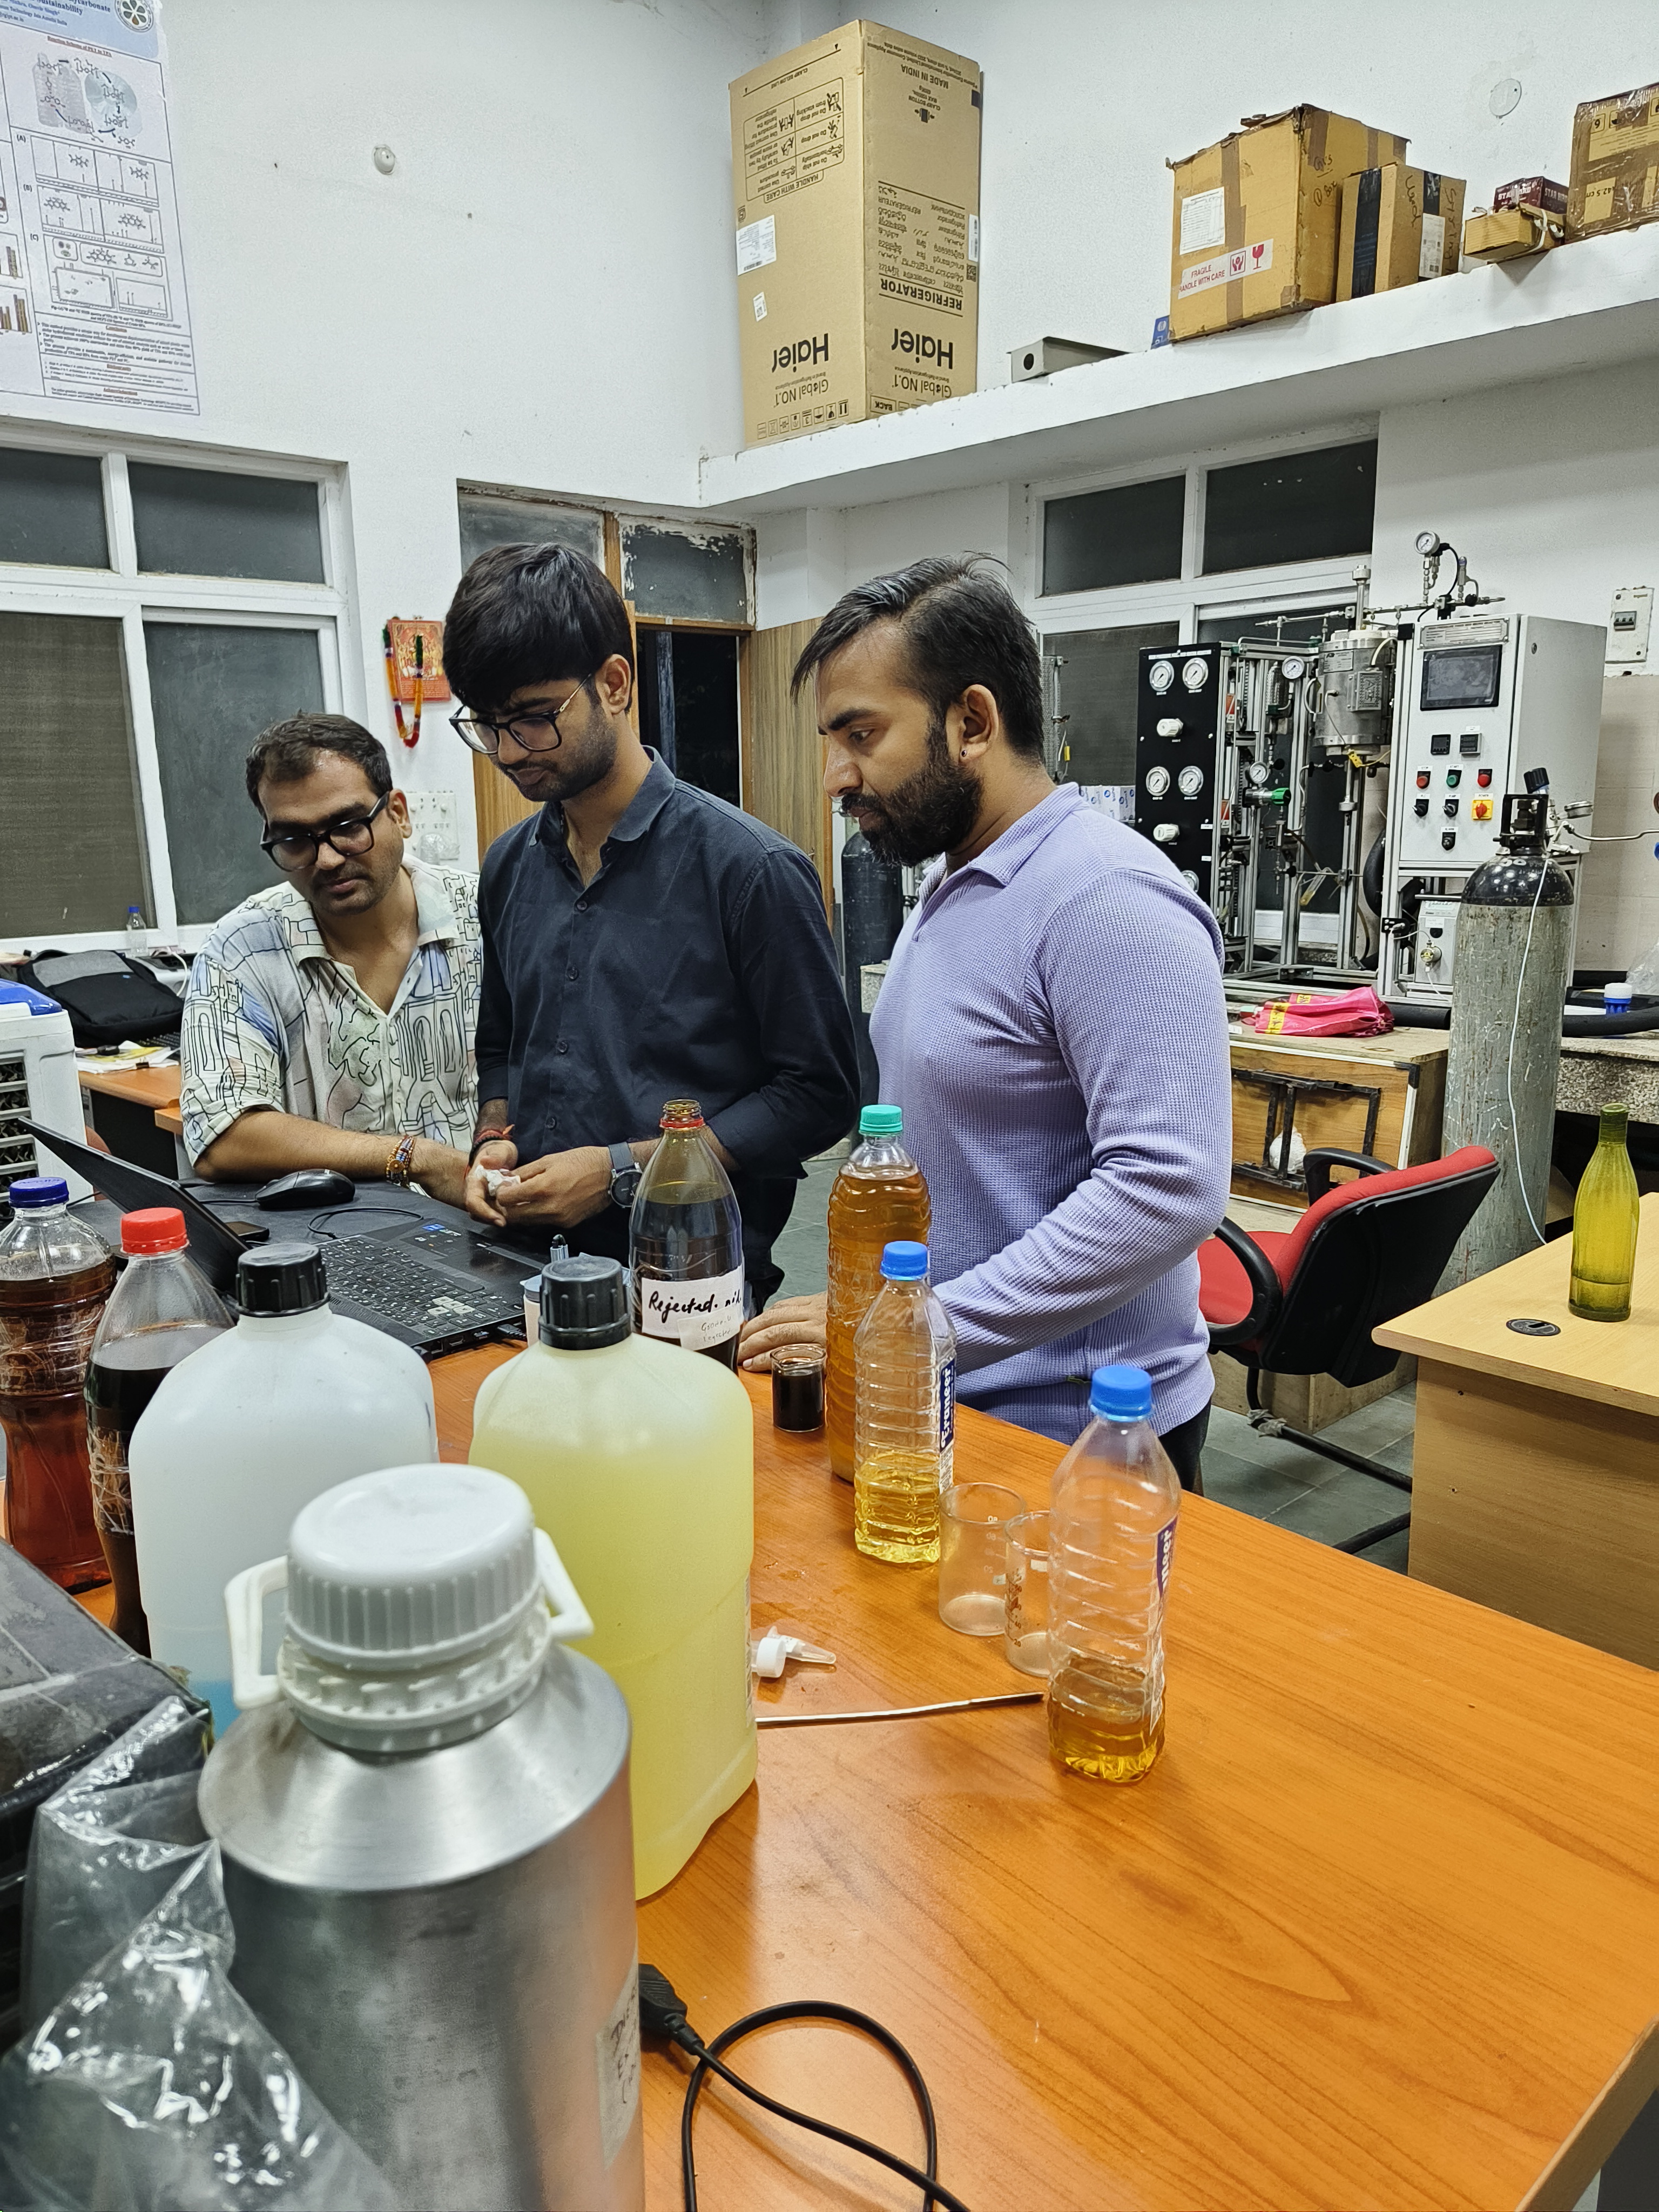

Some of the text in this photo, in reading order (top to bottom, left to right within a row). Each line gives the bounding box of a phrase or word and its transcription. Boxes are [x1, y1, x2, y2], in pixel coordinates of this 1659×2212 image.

[37, 0, 83, 15] ustainability
[901, 64, 949, 89] MADE IN INDIA
[766, 174, 819, 200] HANDLE WITH CARE
[878, 196, 921, 215] RÉFRIGÉRATEUR
[1191, 265, 1211, 279] FRAGILE
[1198, 276, 1210, 286] WITH
[1211, 269, 1225, 281] CARE
[880, 278, 962, 311] REFRIGERATOR
[771, 333, 829, 374] Haier
[891, 328, 954, 370] Haier
[799, 379, 828, 400] Global
[921, 380, 952, 399] Global
[874, 401, 893, 411] BACK
